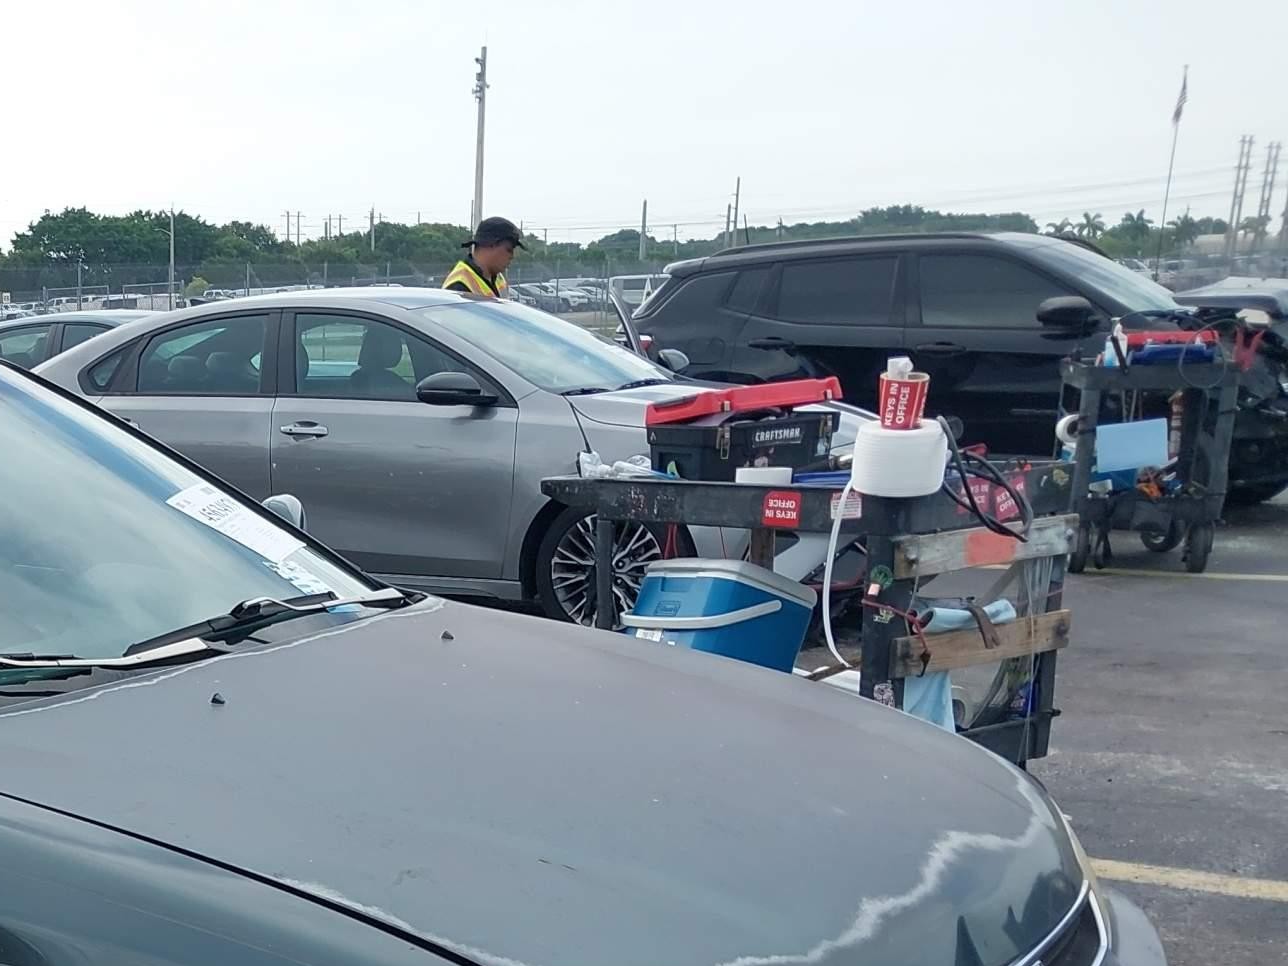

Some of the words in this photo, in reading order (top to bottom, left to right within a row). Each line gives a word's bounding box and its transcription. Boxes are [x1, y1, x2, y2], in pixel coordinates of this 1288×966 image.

[889, 383, 899, 395] IN
[895, 386, 910, 424] OFFICE
[884, 397, 896, 426] KEYS
[755, 427, 801, 442] CRAFTSMAN
[768, 498, 796, 509] OFFICE
[765, 509, 774, 518] IN
[776, 510, 797, 520] KEYS
